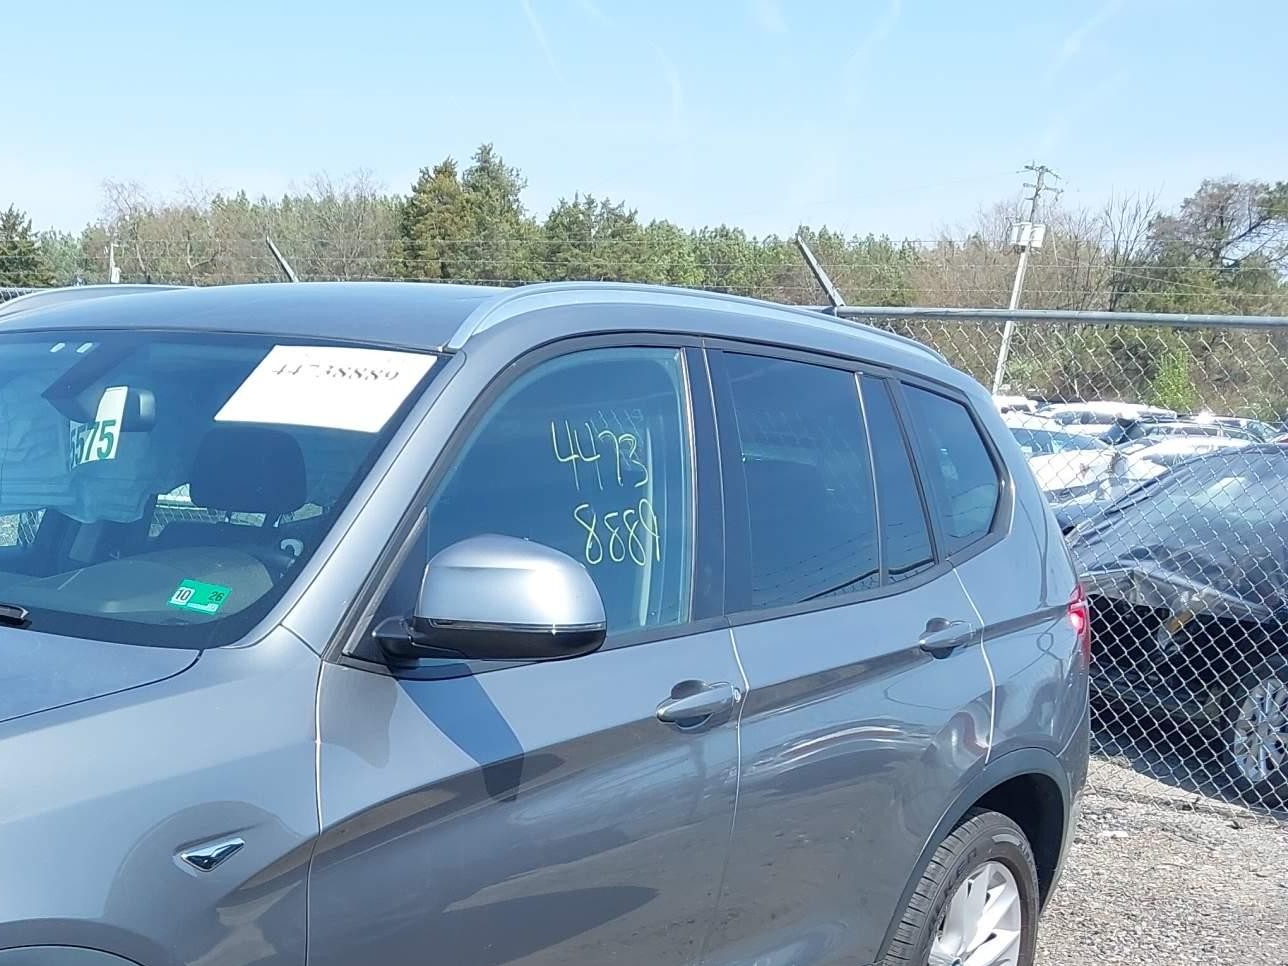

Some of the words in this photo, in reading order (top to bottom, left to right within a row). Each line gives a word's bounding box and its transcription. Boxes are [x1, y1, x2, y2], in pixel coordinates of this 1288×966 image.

[550, 420, 650, 491] 4473
[573, 497, 661, 567] 8889
[175, 589, 192, 601] 10
[207, 591, 225, 602] 26
